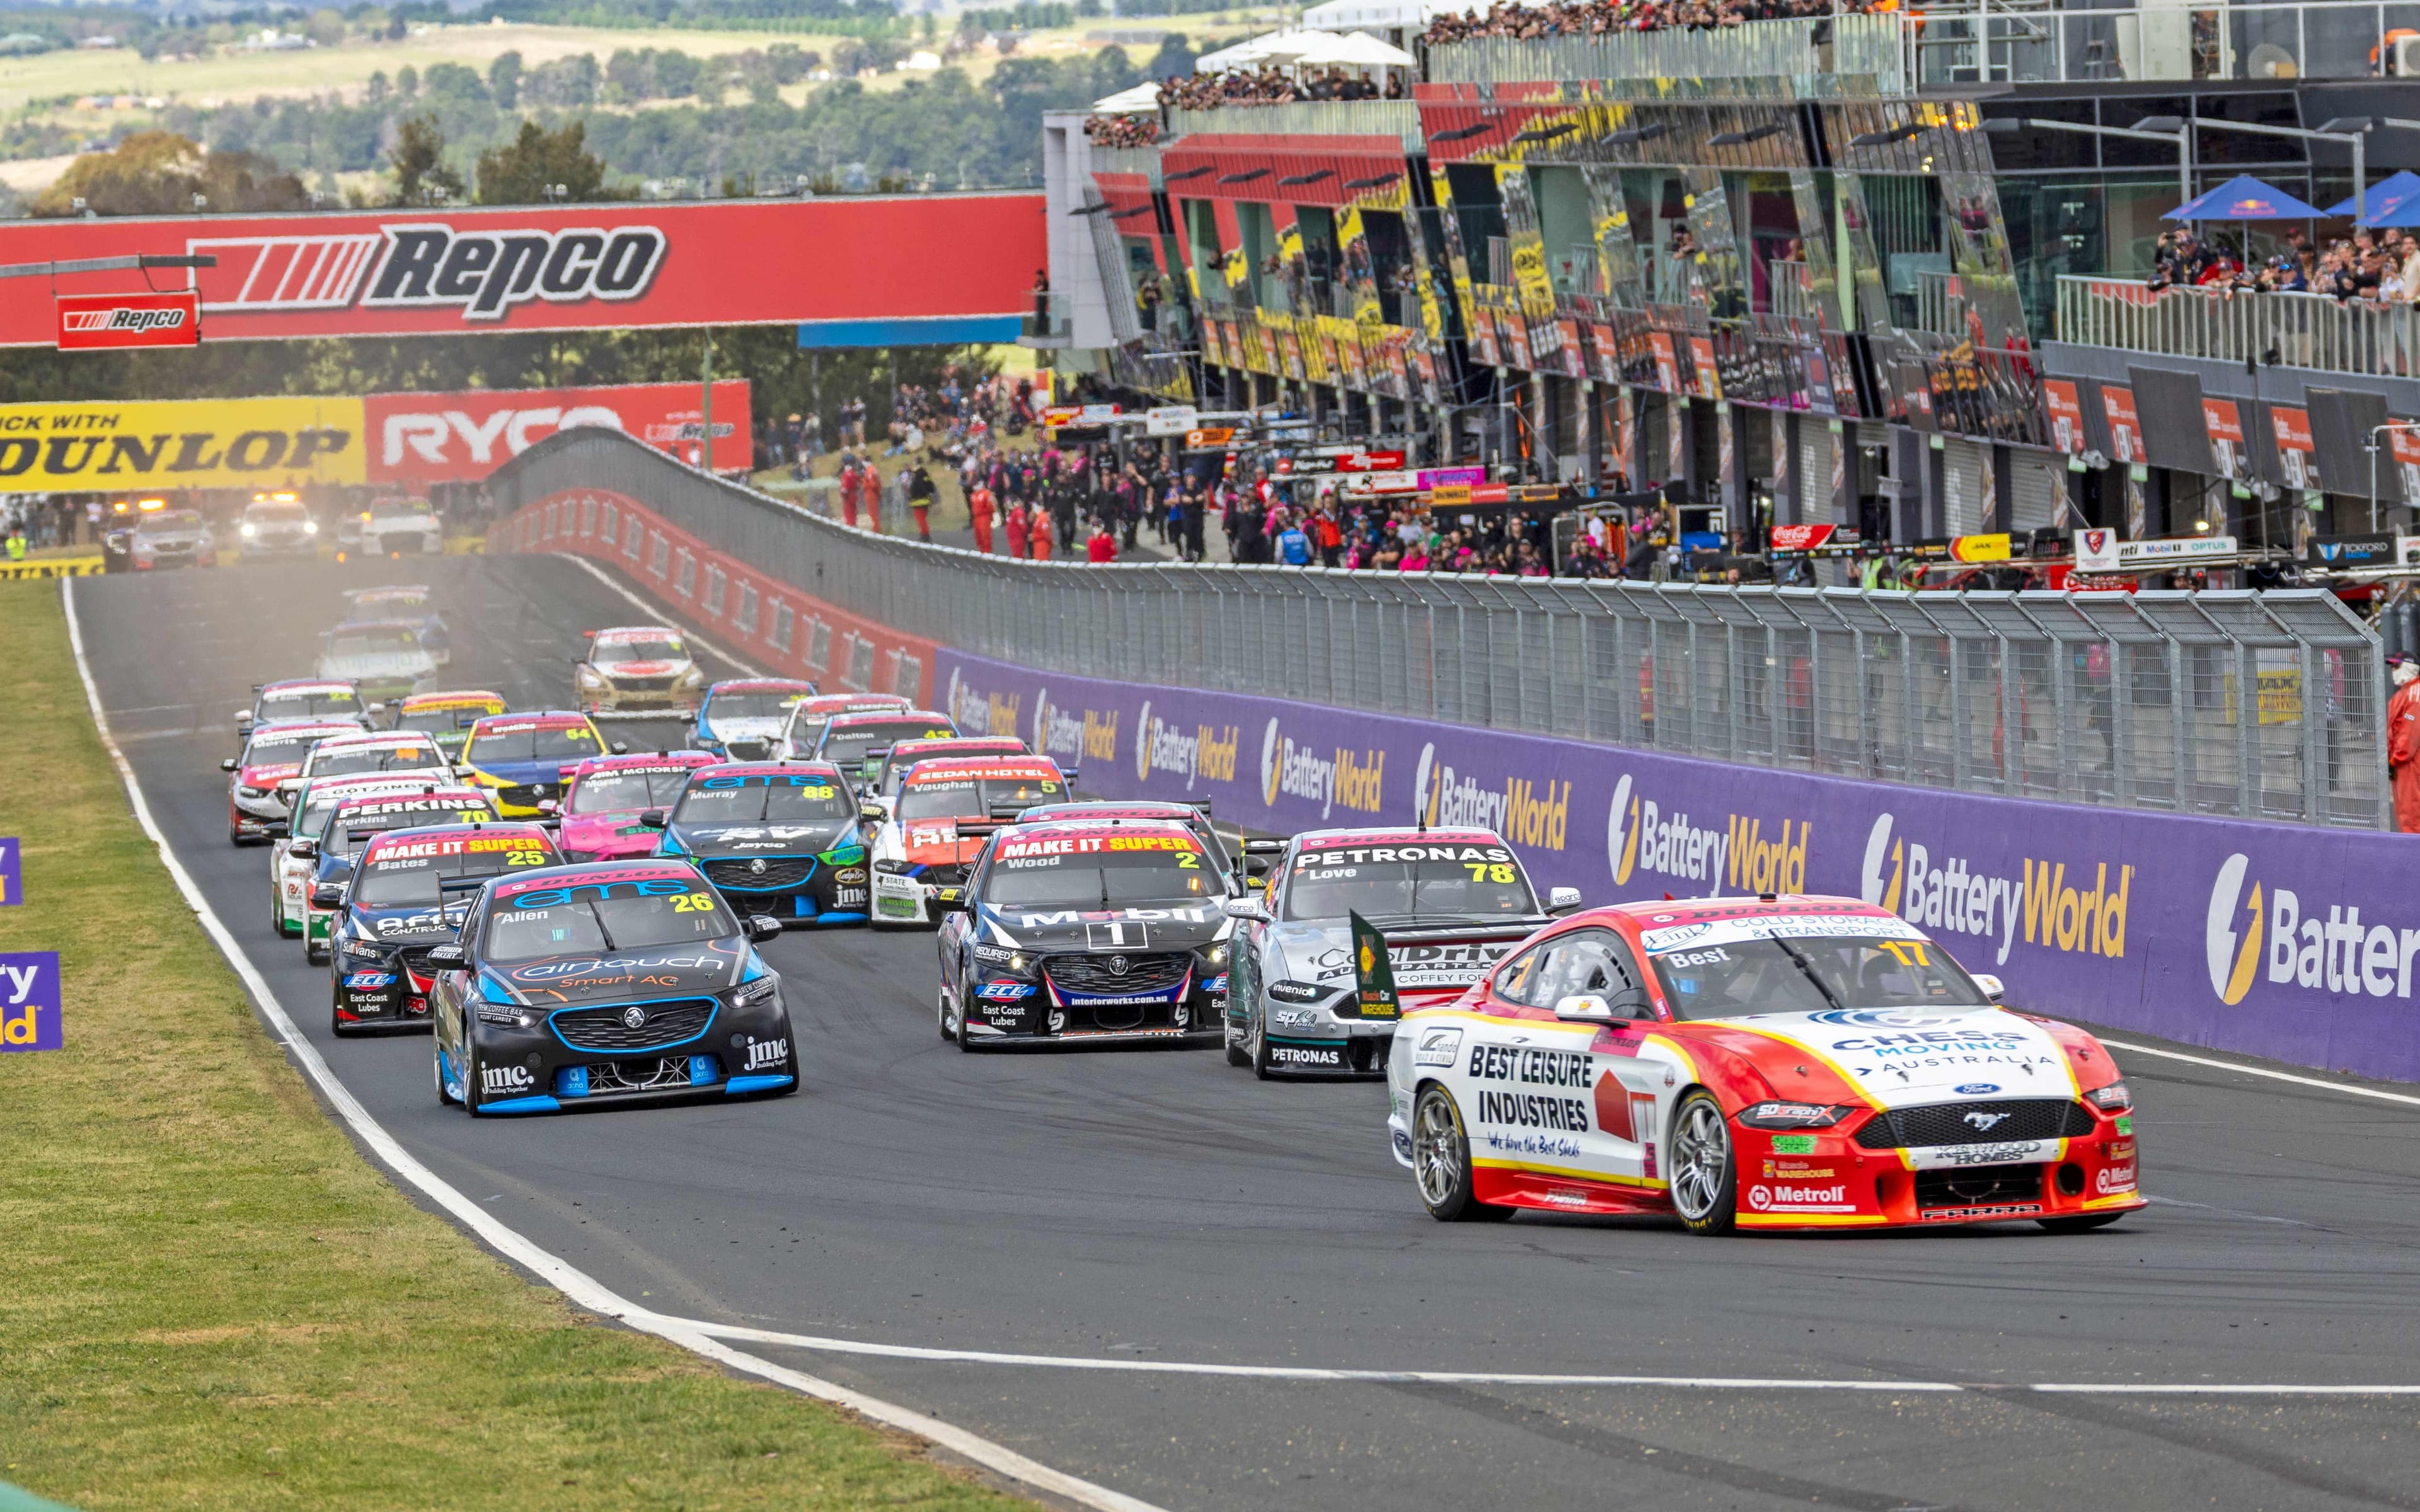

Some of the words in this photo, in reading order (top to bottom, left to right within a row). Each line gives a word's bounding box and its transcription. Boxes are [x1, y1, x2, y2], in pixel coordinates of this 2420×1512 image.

[362, 225, 664, 317] Repco
[110, 307, 186, 333] Repco
[52, 413, 121, 429] WITH
[0, 430, 350, 476] DUNLOP
[2121, 544, 2138, 556] nti
[2146, 544, 2172, 553] Mobil
[2191, 541, 2227, 551] OPTUS
[836, 731, 874, 740] Dalton
[918, 770, 982, 780] SEDAN
[986, 768, 1049, 777] HOTEL
[802, 785, 834, 799] 88
[914, 781, 976, 793] Vaughan
[1041, 780, 1057, 793] 5
[691, 789, 738, 801] Murray
[339, 798, 487, 818] PERKINS
[337, 816, 388, 827] Perkins
[456, 810, 491, 823] 70
[1005, 839, 1074, 857] MAKE
[1080, 838, 1103, 851] IT
[1110, 837, 1192, 851] SUPER
[1339, 833, 1482, 845] DUNLOP
[374, 843, 437, 861] MAKE
[443, 841, 463, 854] IT
[469, 839, 543, 852] SUPER
[506, 850, 545, 866] 25
[378, 859, 429, 871] Bates
[1008, 856, 1060, 869] Wood
[1175, 852, 1200, 869] 2
[1296, 849, 1511, 868] PETRONAS
[539, 869, 688, 886] DUNLOP
[885, 876, 906, 886] STATE
[1310, 868, 1357, 880] Love
[1464, 864, 1516, 883] 78
[669, 893, 714, 913] 26
[833, 885, 868, 908] jmc
[501, 909, 548, 924] Allen
[1020, 907, 1206, 928] Mobil
[1690, 905, 1866, 919] DUNLOP
[1731, 916, 1801, 928] COLD
[1802, 915, 1910, 928] STORAGE
[1103, 922, 1125, 944] 1
[1774, 925, 1908, 937] TRANSPORT
[342, 942, 377, 958] Sullivans
[1668, 947, 1731, 968] Best
[1879, 941, 1930, 966] 17
[523, 956, 723, 976] airtouch
[1398, 974, 1454, 983] COFFEY
[350, 994, 365, 1002] East
[366, 994, 388, 1002] Coast
[1380, 990, 1390, 1001] Car
[358, 1004, 380, 1012] Lubes
[488, 1004, 508, 1014] COFFEE
[510, 1008, 523, 1016] BAR
[982, 1005, 999, 1016] East
[1001, 1005, 1025, 1016] Coast
[991, 1016, 1016, 1026] Lubes
[1603, 1035, 1642, 1048] DUNLOP
[1833, 1030, 2027, 1051] CHESS
[1272, 1048, 1339, 1064] PETRONAS
[1874, 1041, 2017, 1058] MOVING
[1469, 1046, 1519, 1080] BEST
[1521, 1050, 1593, 1088] LEISURE
[1884, 1055, 2055, 1072] AUSTRALIA
[1962, 1084, 1993, 1093] Ford
[1479, 1091, 1588, 1132] INDUSTRIES
[1488, 1131, 1503, 1150] We
[1506, 1133, 1523, 1152] have
[1524, 1135, 1537, 1154] the
[1539, 1135, 1556, 1155] Best
[1558, 1137, 1581, 1158] Sheds
[1934, 1140, 2042, 1159] KENWOOD
[1955, 1152, 2024, 1164] HOMES
[1774, 1186, 1844, 1202] Metroll
[1922, 1204, 2043, 1220] FARRA
